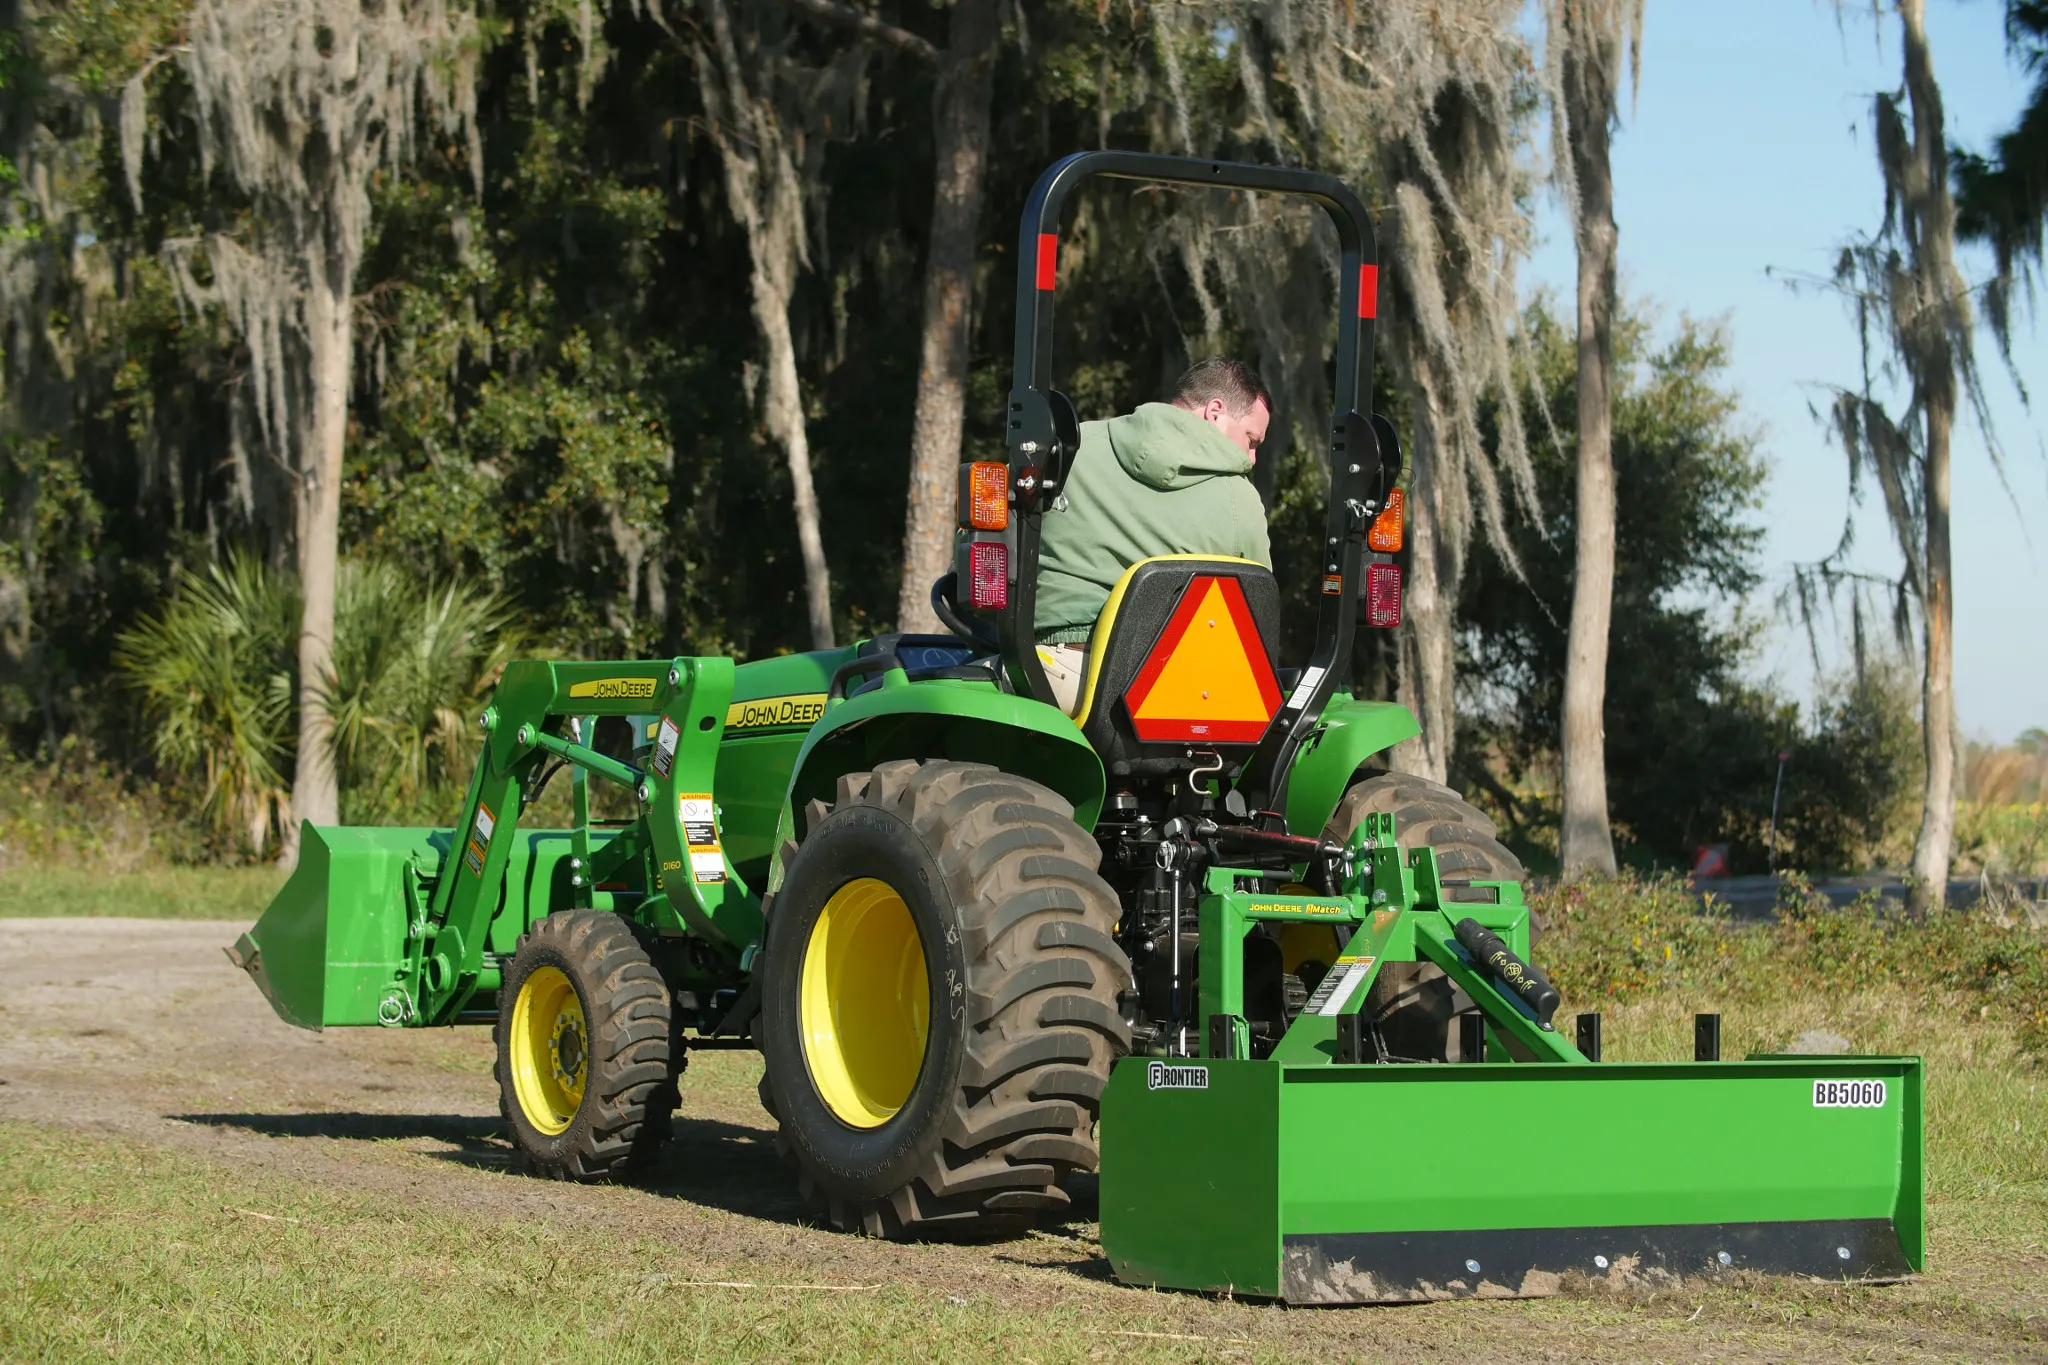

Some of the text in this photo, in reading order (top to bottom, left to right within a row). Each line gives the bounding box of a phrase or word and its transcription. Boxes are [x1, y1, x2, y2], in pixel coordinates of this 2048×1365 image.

[594, 681, 652, 696] JOHN DEERE
[737, 702, 827, 724] JOHN DEER
[663, 861, 681, 871] D160
[1249, 903, 1272, 912] JOHN
[1273, 903, 1302, 913] DEERE
[1149, 1063, 1207, 1088] FRONTIER
[1815, 1082, 1883, 1104] BB5060
